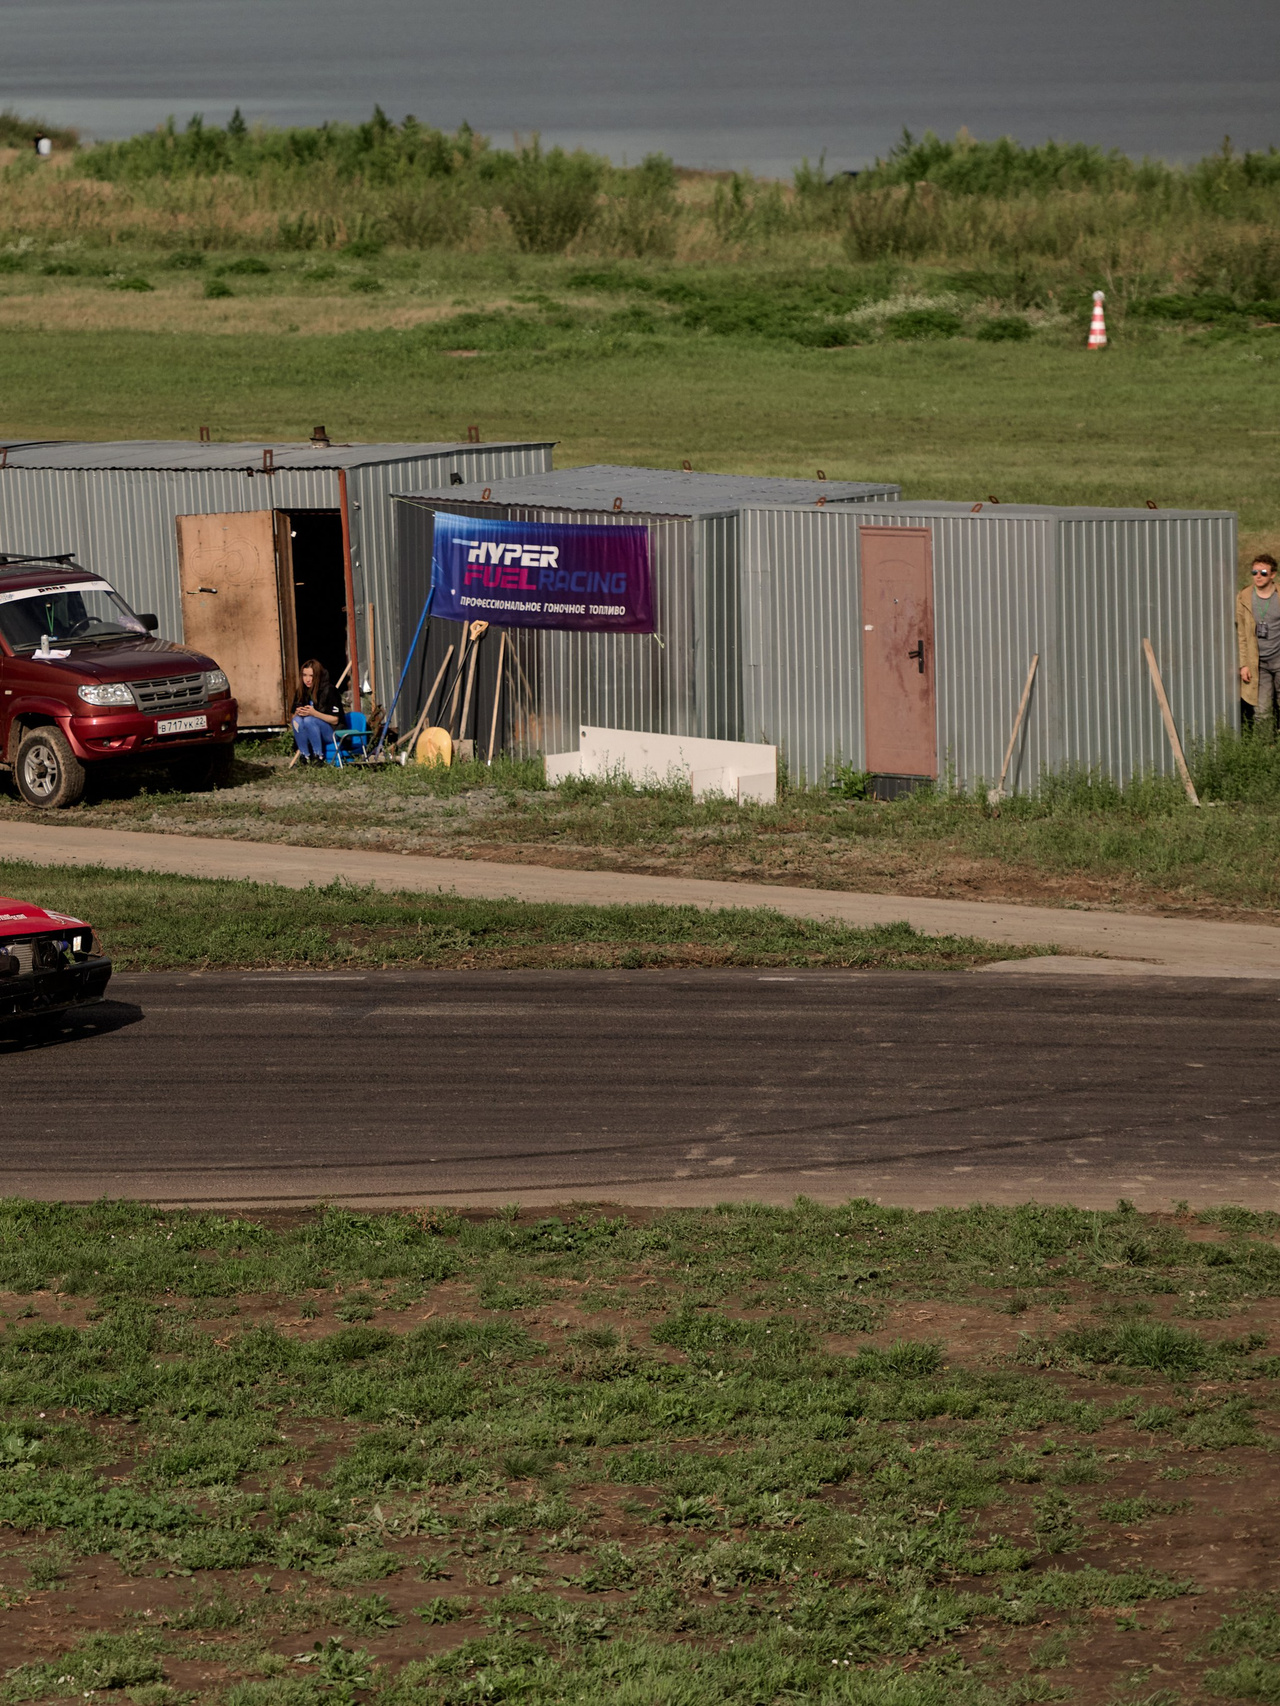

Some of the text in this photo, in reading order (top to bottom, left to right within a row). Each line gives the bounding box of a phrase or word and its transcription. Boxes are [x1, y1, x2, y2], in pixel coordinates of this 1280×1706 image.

[467, 541, 560, 568] HYPER
[464, 564, 628, 594] FUEL RACING
[460, 596, 626, 616] ПРОФЕССИОНАЛЬНОЕ ГОНОЧНОЕ ТОПЛИВО
